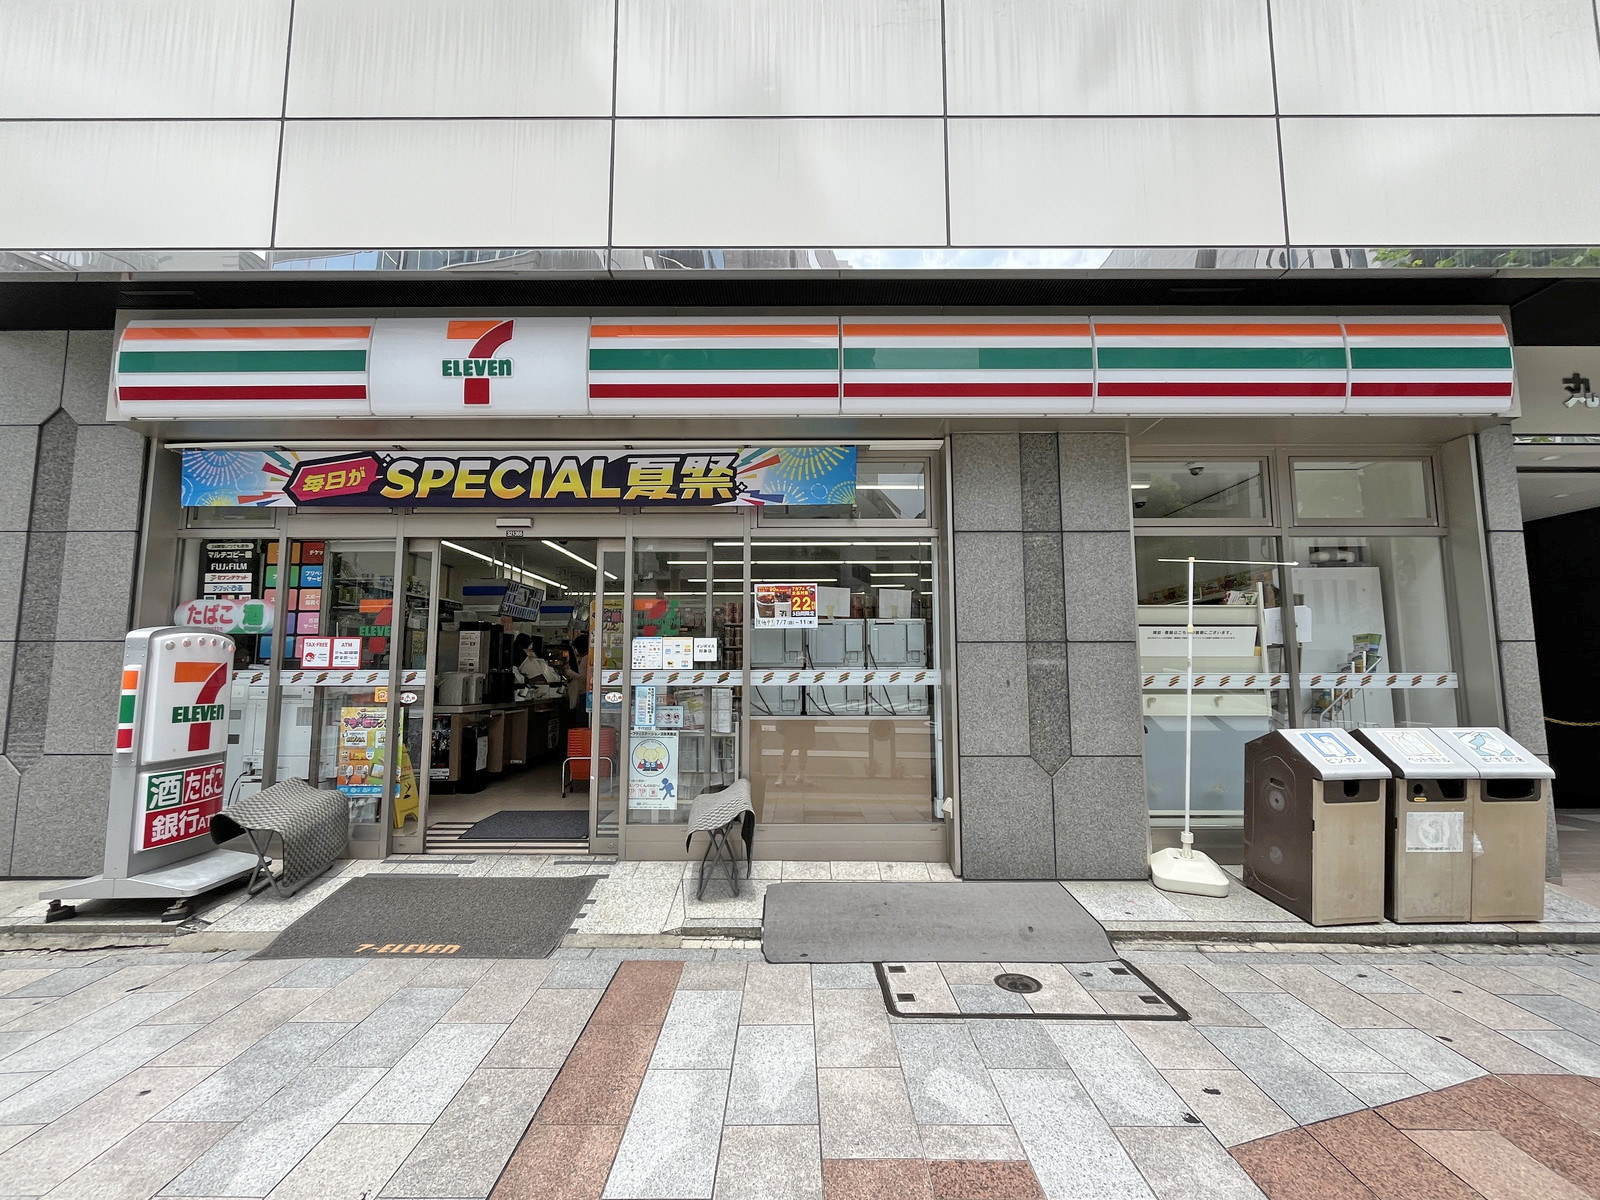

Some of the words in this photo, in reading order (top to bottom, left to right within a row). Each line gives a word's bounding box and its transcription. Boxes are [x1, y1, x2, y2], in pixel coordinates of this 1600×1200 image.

[303, 466, 366, 492] 毎日が
[187, 604, 233, 625] たばこ
[149, 774, 183, 810] 酒
[185, 767, 224, 803] たばこ
[151, 806, 215, 843] 銀行AT
